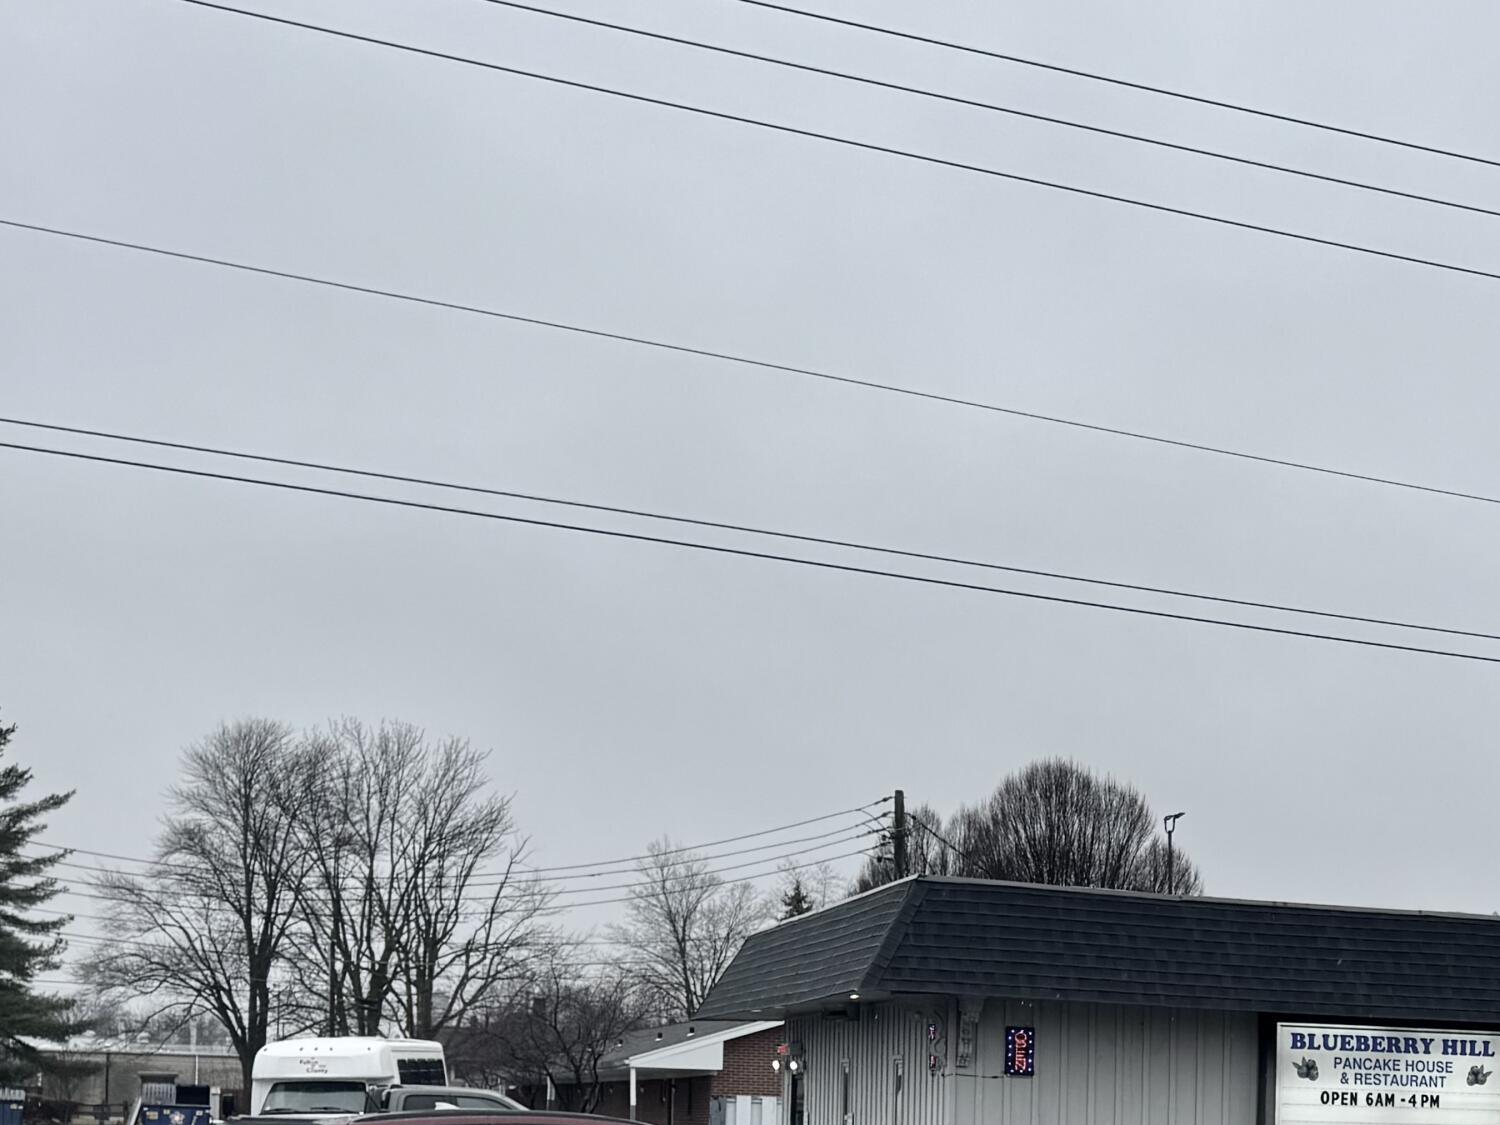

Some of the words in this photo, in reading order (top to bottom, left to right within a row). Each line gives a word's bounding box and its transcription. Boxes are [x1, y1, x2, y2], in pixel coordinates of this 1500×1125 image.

[1290, 1032, 1436, 1055] BLUEBERRY
[1441, 1039, 1495, 1057] HILL
[1333, 1056, 1401, 1072] PANCAKE
[1405, 1060, 1453, 1073] HOUSE
[1340, 1072, 1349, 1085] &
[1354, 1073, 1446, 1088] RESTAURANT
[1320, 1091, 1357, 1106] OPEN
[1366, 1092, 1395, 1107] 6AM
